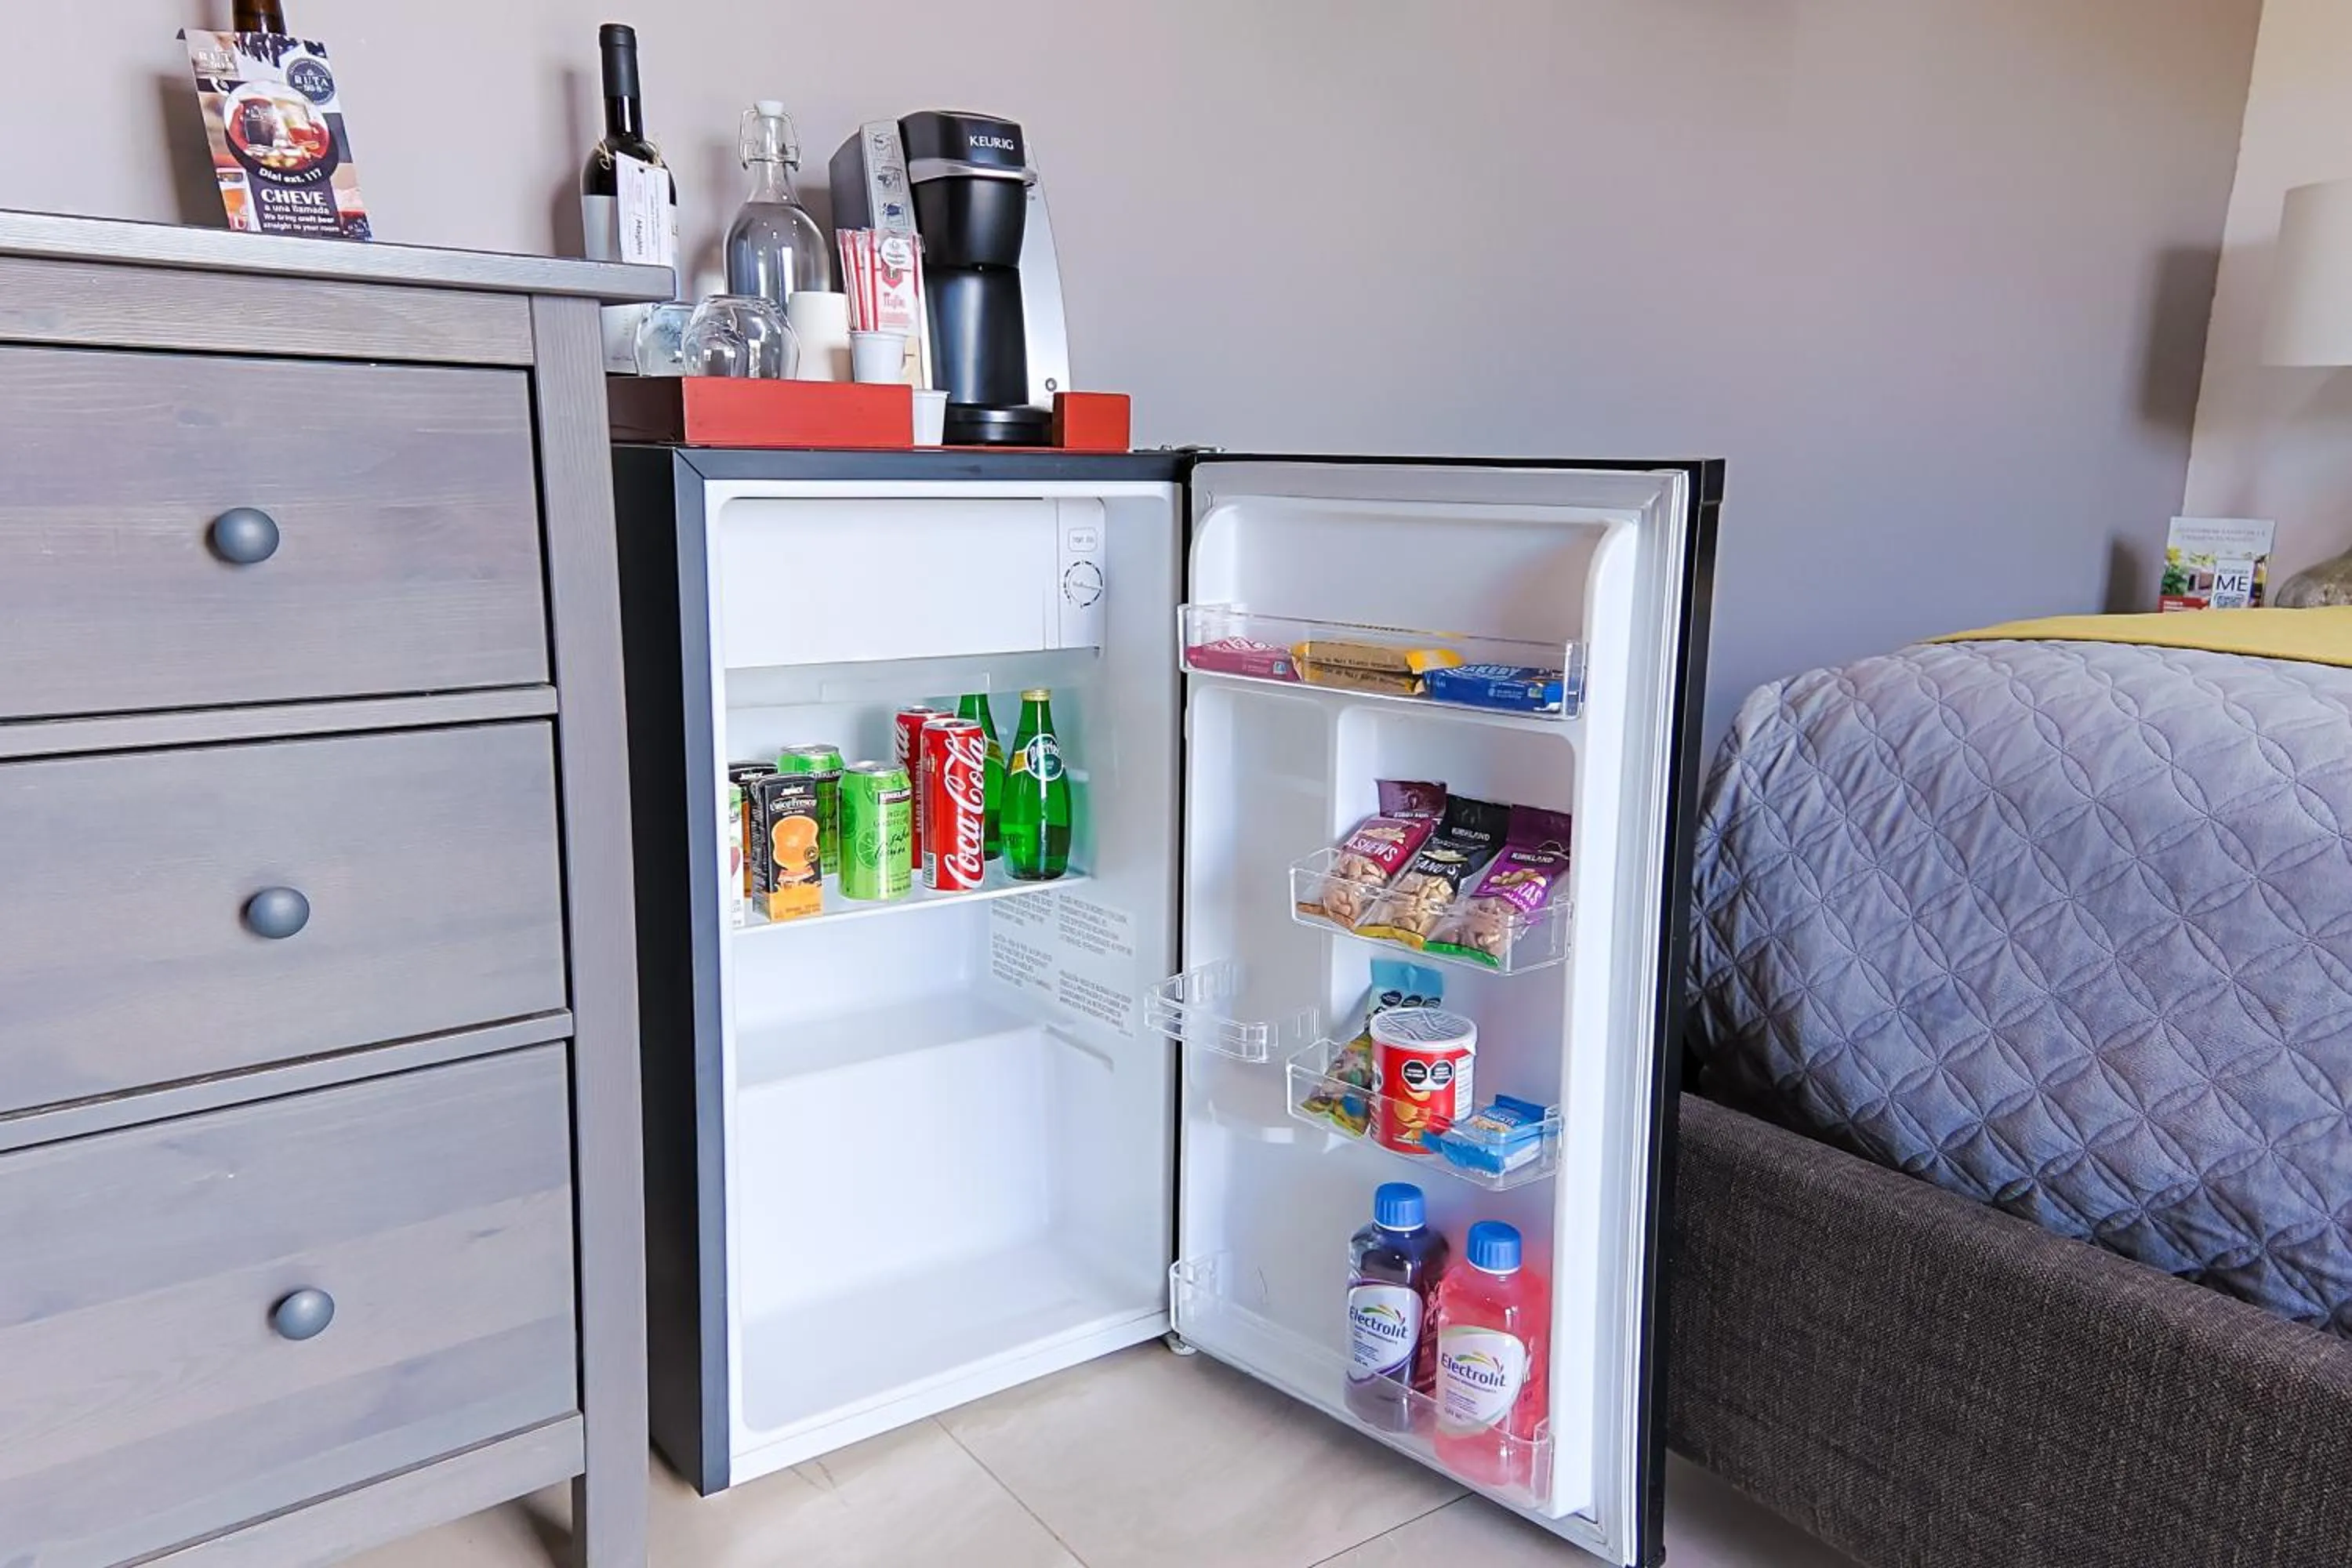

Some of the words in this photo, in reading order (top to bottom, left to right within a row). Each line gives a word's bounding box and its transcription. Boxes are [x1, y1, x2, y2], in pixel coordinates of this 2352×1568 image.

[294, 74, 328, 86] RUTA
[969, 135, 1014, 151] KEURIG
[261, 188, 327, 206] CHEVE
[2216, 575, 2249, 592] ME
[1349, 1305, 1408, 1339] Electrolit
[1441, 1352, 1506, 1387] Electrolit
